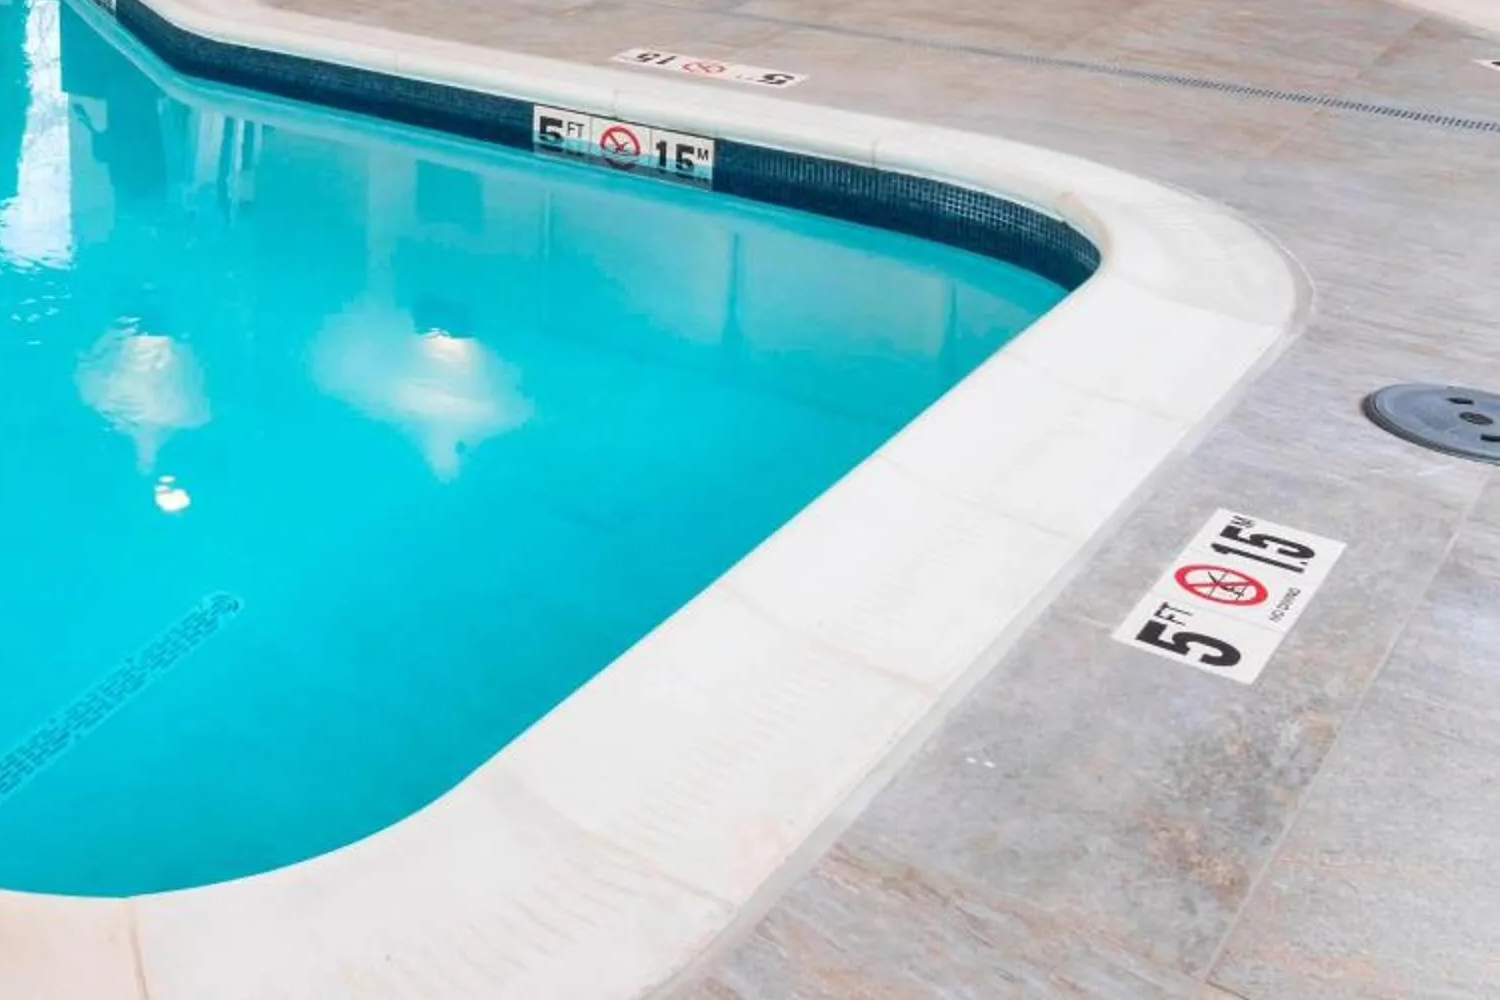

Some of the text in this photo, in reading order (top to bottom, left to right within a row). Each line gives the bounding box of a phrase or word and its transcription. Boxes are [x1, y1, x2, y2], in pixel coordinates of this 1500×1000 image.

[539, 115, 564, 145] 5
[567, 121, 584, 138] FT
[697, 148, 709, 161] M
[1211, 524, 1315, 574] 1.5
[1135, 601, 1241, 667] 5 FT
